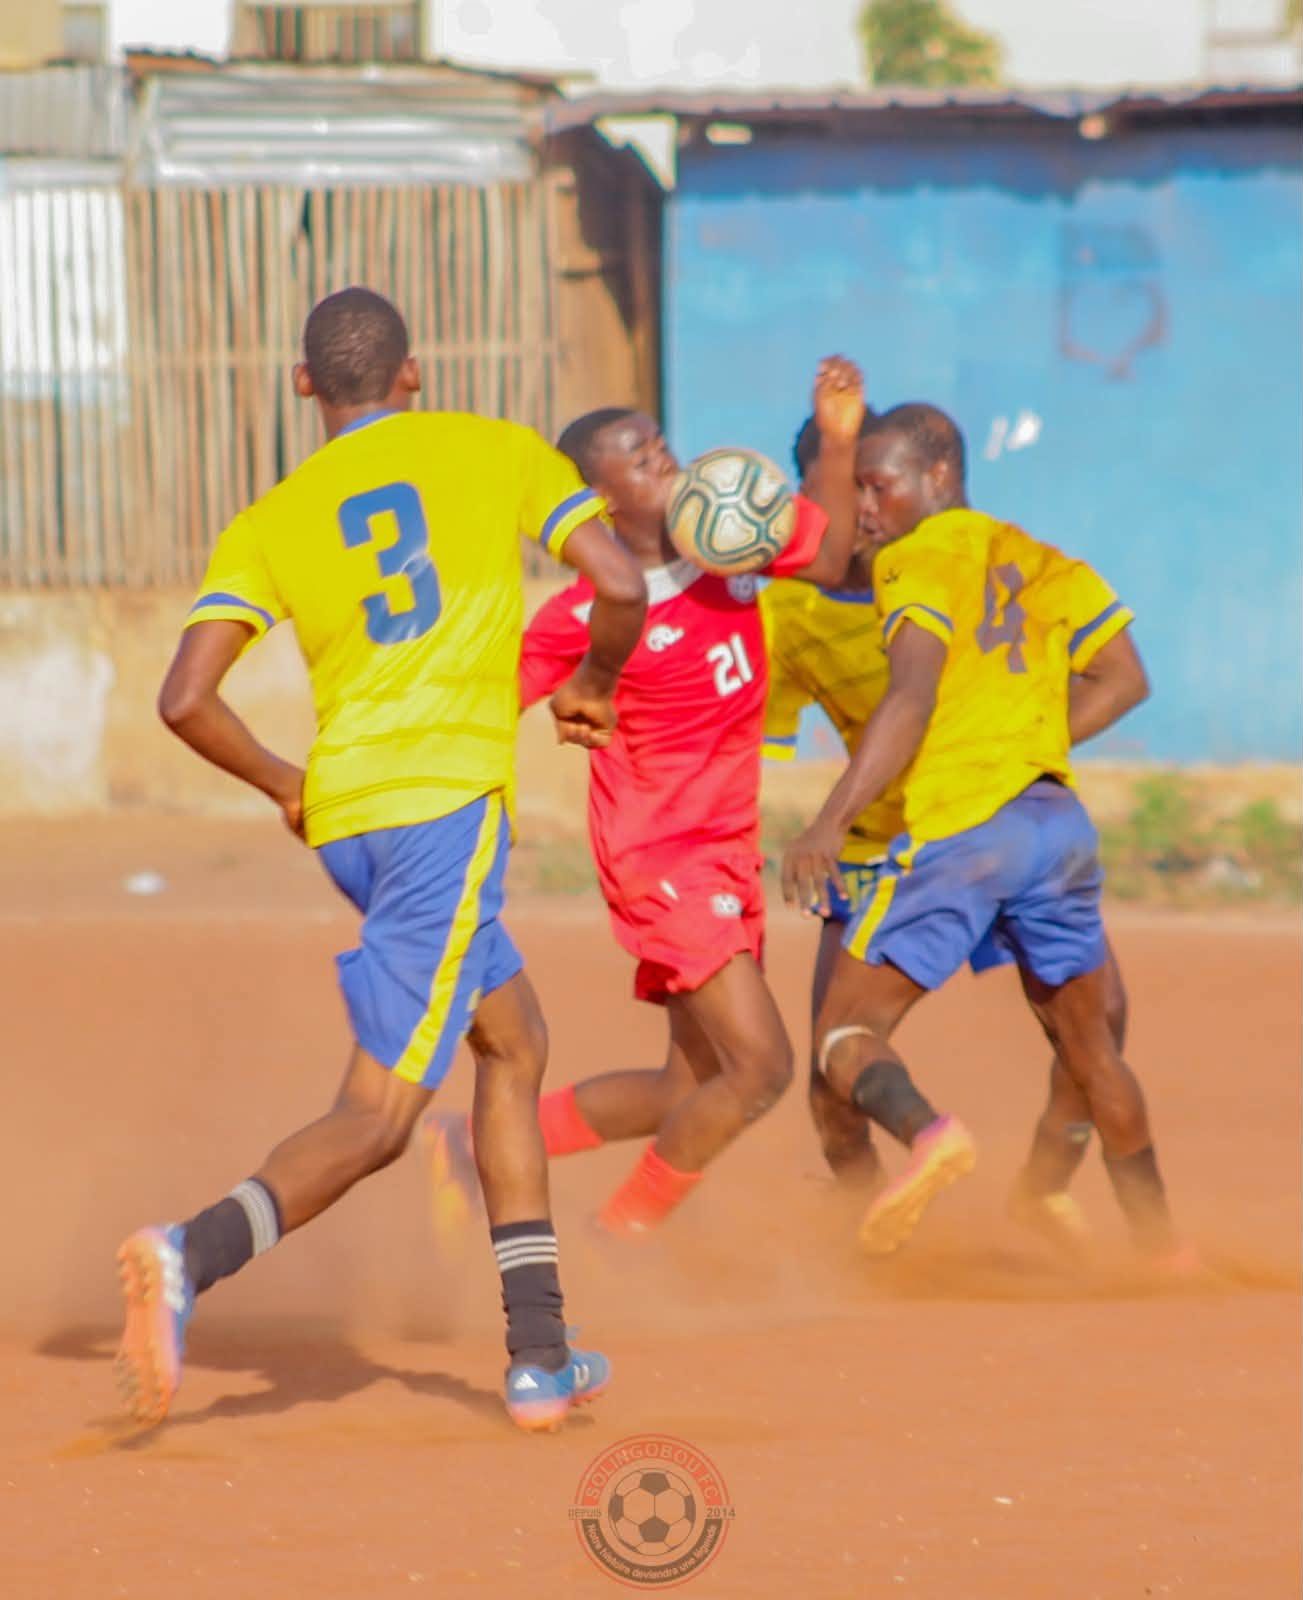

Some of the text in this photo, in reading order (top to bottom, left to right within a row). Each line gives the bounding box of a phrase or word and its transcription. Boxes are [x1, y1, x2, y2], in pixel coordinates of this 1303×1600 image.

[337, 481, 441, 645] 3
[976, 561, 1027, 674] 4
[706, 632, 753, 697] 21
